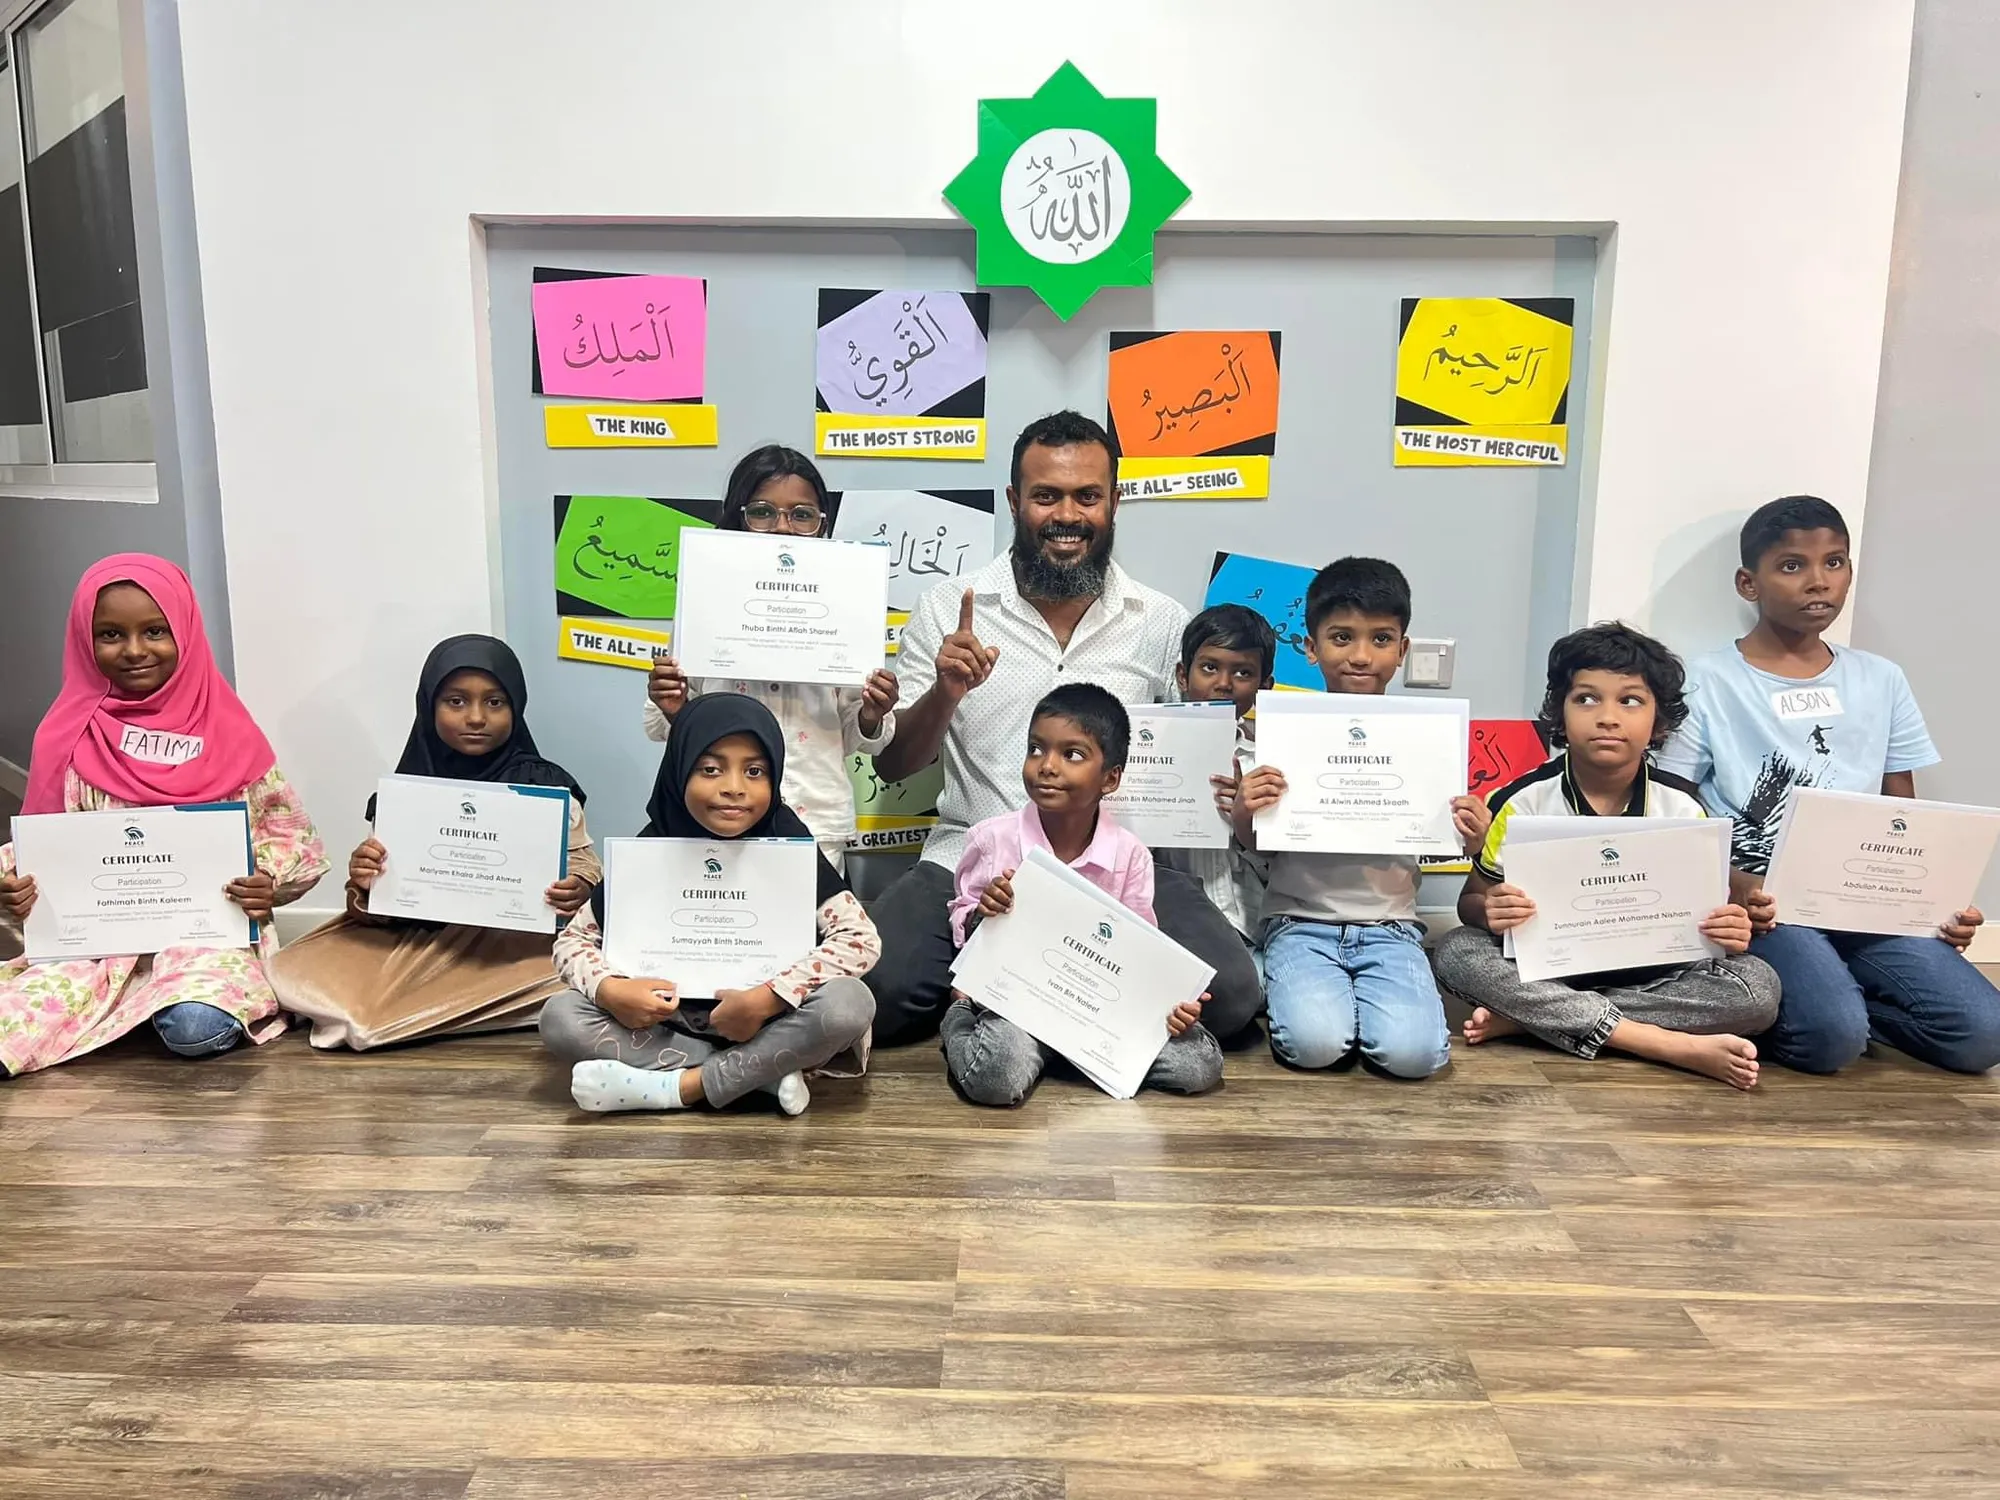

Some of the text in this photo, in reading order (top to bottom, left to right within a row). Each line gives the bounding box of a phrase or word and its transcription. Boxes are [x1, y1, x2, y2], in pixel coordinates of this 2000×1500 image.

[595, 418, 666, 436] THE KING
[828, 430, 975, 447] THE MOST STRONG
[1402, 432, 1559, 461] THE MOST MERCIFUL
[1117, 482, 1138, 496] HE
[1187, 472, 1238, 489] SEEING
[755, 581, 820, 593] CERTIFICATE
[741, 624, 765, 633] Thuba
[573, 633, 603, 650] THE
[1780, 691, 1831, 715] ALSON
[123, 731, 201, 758] FATIMA
[1126, 755, 1175, 765] RTIFICATE
[1327, 755, 1393, 765] CERTIFICATE
[1353, 798, 1382, 806] Ahmed
[439, 827, 499, 842] CERTIFICATE
[862, 828, 931, 847] GREATEST
[1860, 842, 1925, 857] CERTIFICATE
[102, 854, 174, 865] CERTIFICATE
[117, 878, 162, 888] Participation
[496, 875, 522, 884] Ahmed
[1580, 872, 1649, 887] CERTIFICATE
[682, 889, 748, 900] CERTIFICATE
[97, 898, 136, 907] Fathimah
[160, 896, 191, 904] Kaleem
[694, 915, 735, 925] Participation
[1619, 913, 1659, 923] Mohamed
[1661, 910, 1691, 919] Nisham
[671, 936, 712, 946] Sumayyah
[734, 937, 763, 946] Shamin
[1063, 935, 1124, 976] CERTIFICATE
